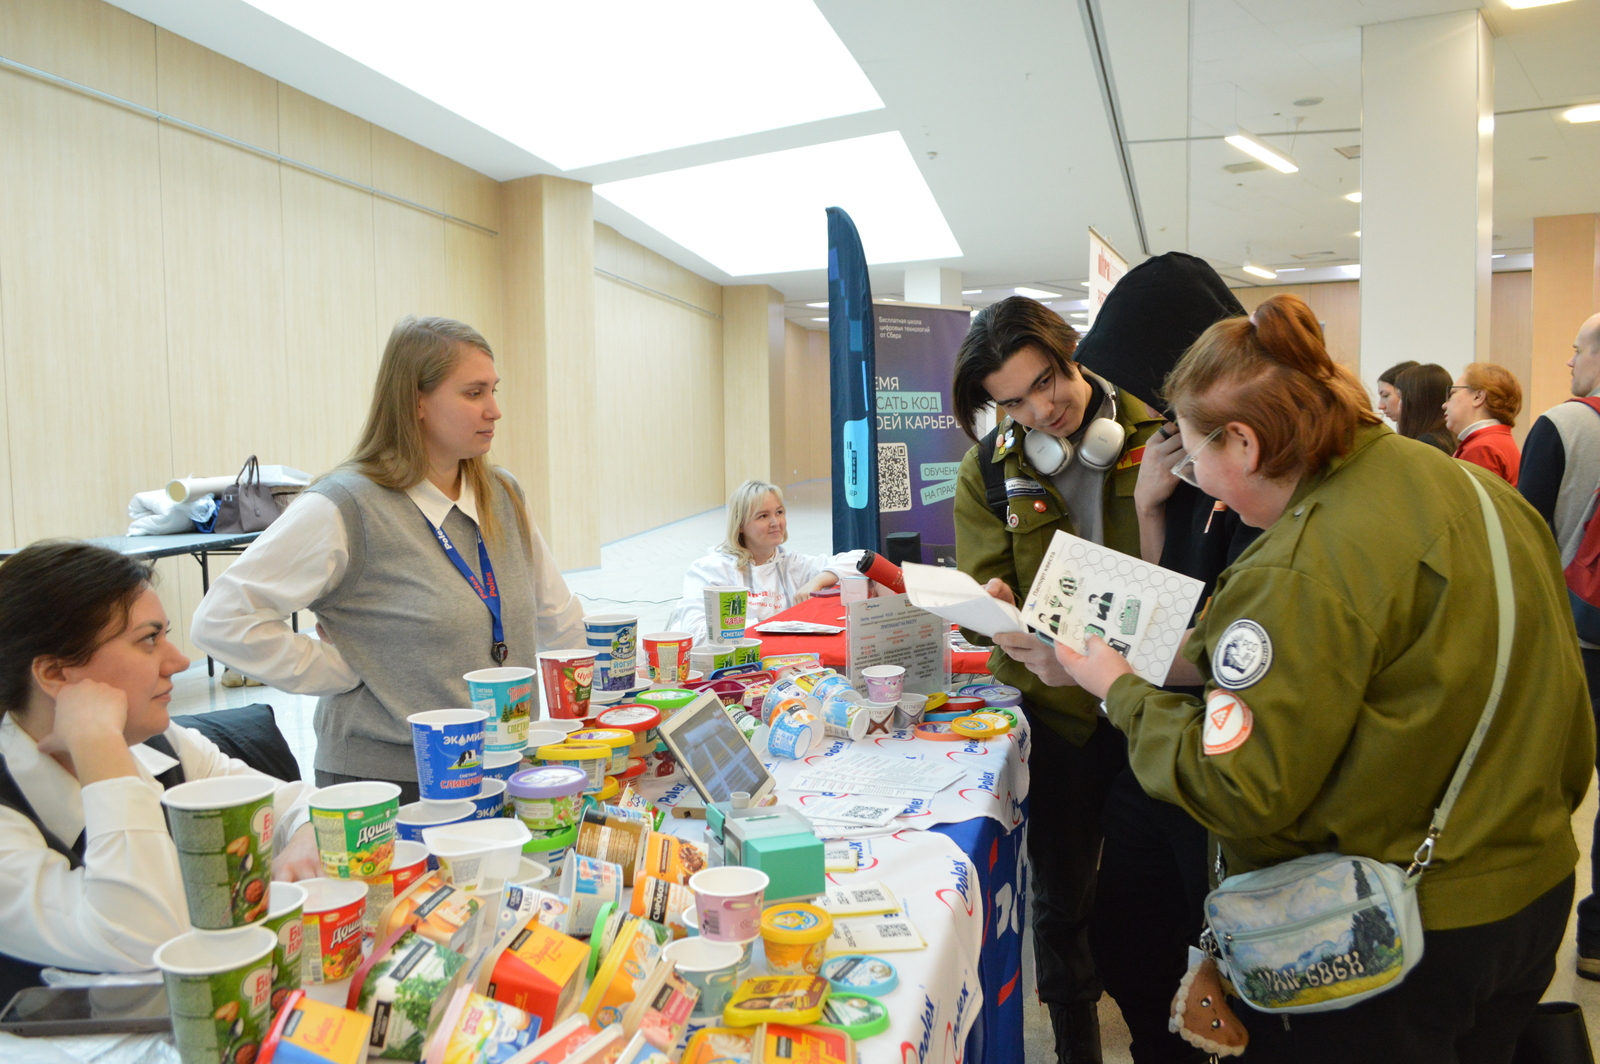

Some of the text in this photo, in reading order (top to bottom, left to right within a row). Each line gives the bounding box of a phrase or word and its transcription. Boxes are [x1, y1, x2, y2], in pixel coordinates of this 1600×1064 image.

[879, 316, 907, 324] Бесплатная
[879, 325, 930, 333] цифровых технологий
[911, 396, 939, 411] КОД
[924, 491, 937, 500] НА
[486, 571, 498, 597] Polex
[1032, 551, 1056, 597] Паспорт квеста
[469, 575, 489, 599] Polex
[881, 621, 901, 630] ПРИГЛАШАЕТ
[657, 782, 688, 803] Polex
[978, 771, 995, 791] Polex
[661, 840, 669, 870] ШОКОЛАДНЫЙ
[951, 859, 969, 902] Polex
[1258, 950, 1365, 992] VAN GOGH
[953, 981, 970, 1050] Polex
[918, 994, 935, 1064] Polex
